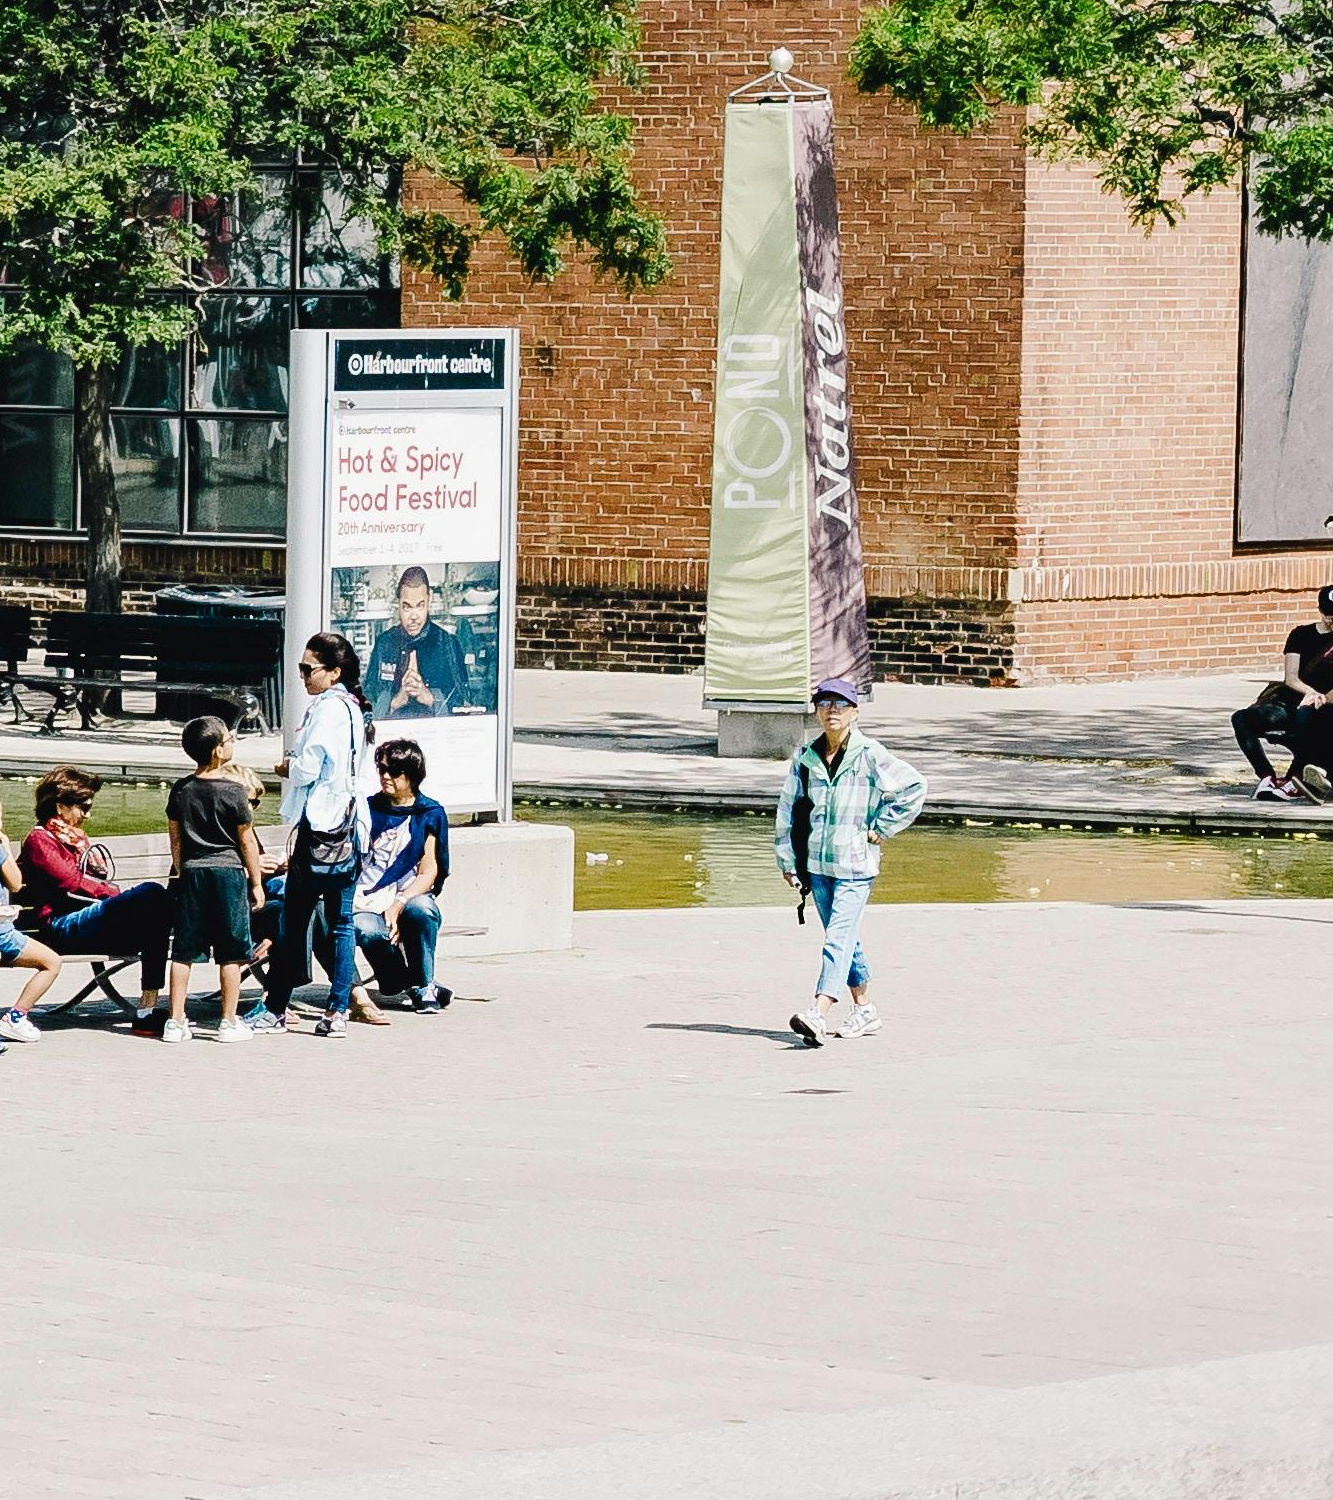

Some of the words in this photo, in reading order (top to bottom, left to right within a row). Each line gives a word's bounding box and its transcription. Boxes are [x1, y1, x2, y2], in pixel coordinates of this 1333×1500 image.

[363, 354, 448, 375] Harbourfront
[450, 353, 492, 374] centre
[723, 333, 792, 509] POND
[805, 287, 852, 532] Natrel
[339, 447, 373, 474] Hot
[380, 446, 397, 473] &
[406, 445, 463, 480] Spicy
[339, 484, 388, 512] Food
[396, 481, 477, 511] Festival
[338, 521, 358, 536] 20th
[361, 521, 425, 536] Anniversary
